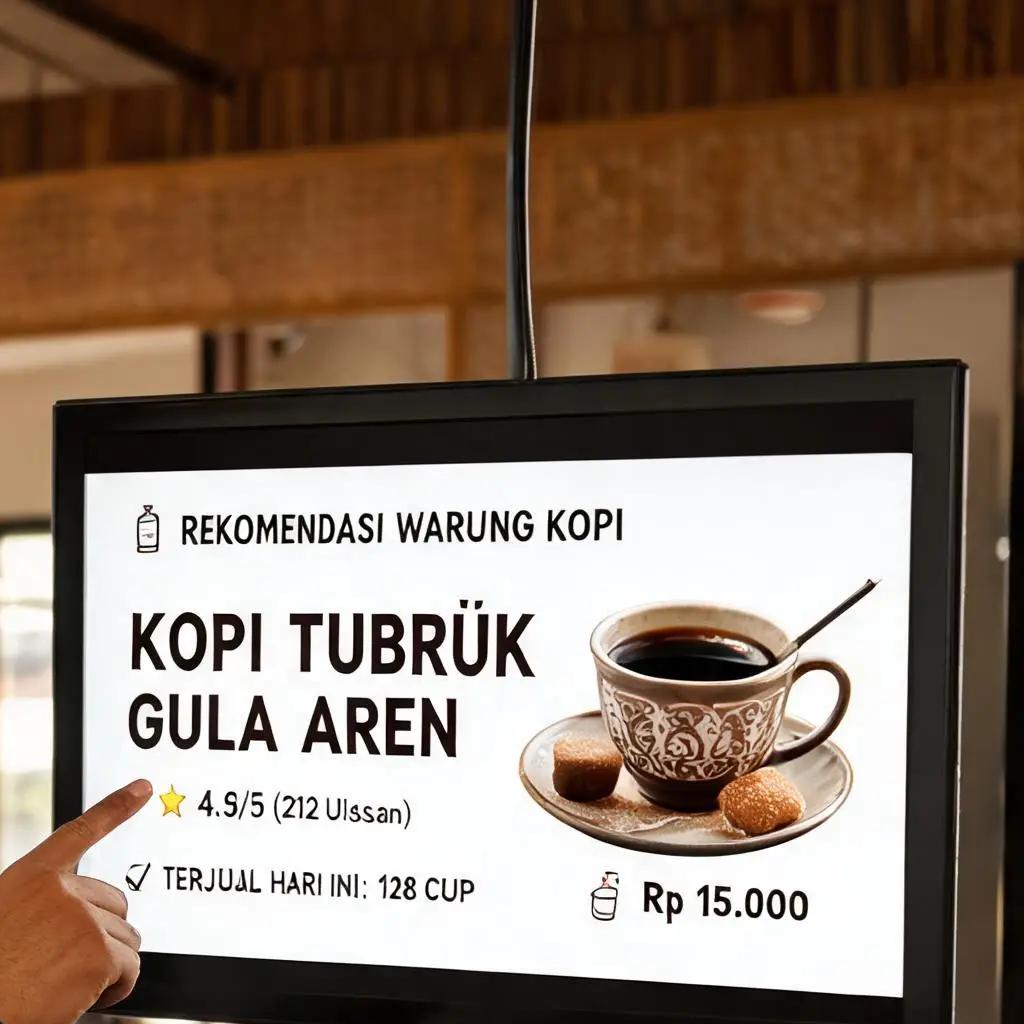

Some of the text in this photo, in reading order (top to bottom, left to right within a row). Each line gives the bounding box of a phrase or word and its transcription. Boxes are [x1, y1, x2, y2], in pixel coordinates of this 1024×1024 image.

[181, 508, 623, 546] REKOMENDASI WARUNG KOPI
[131, 599, 536, 678] KOPI TUBRÜK
[128, 692, 457, 758] GULA AREN
[197, 789, 265, 820] 4.9/5
[273, 791, 320, 825] (212
[162, 866, 475, 903] TERJUAL HARI INI: 128 CUP
[643, 881, 809, 925] Rp 15.000
